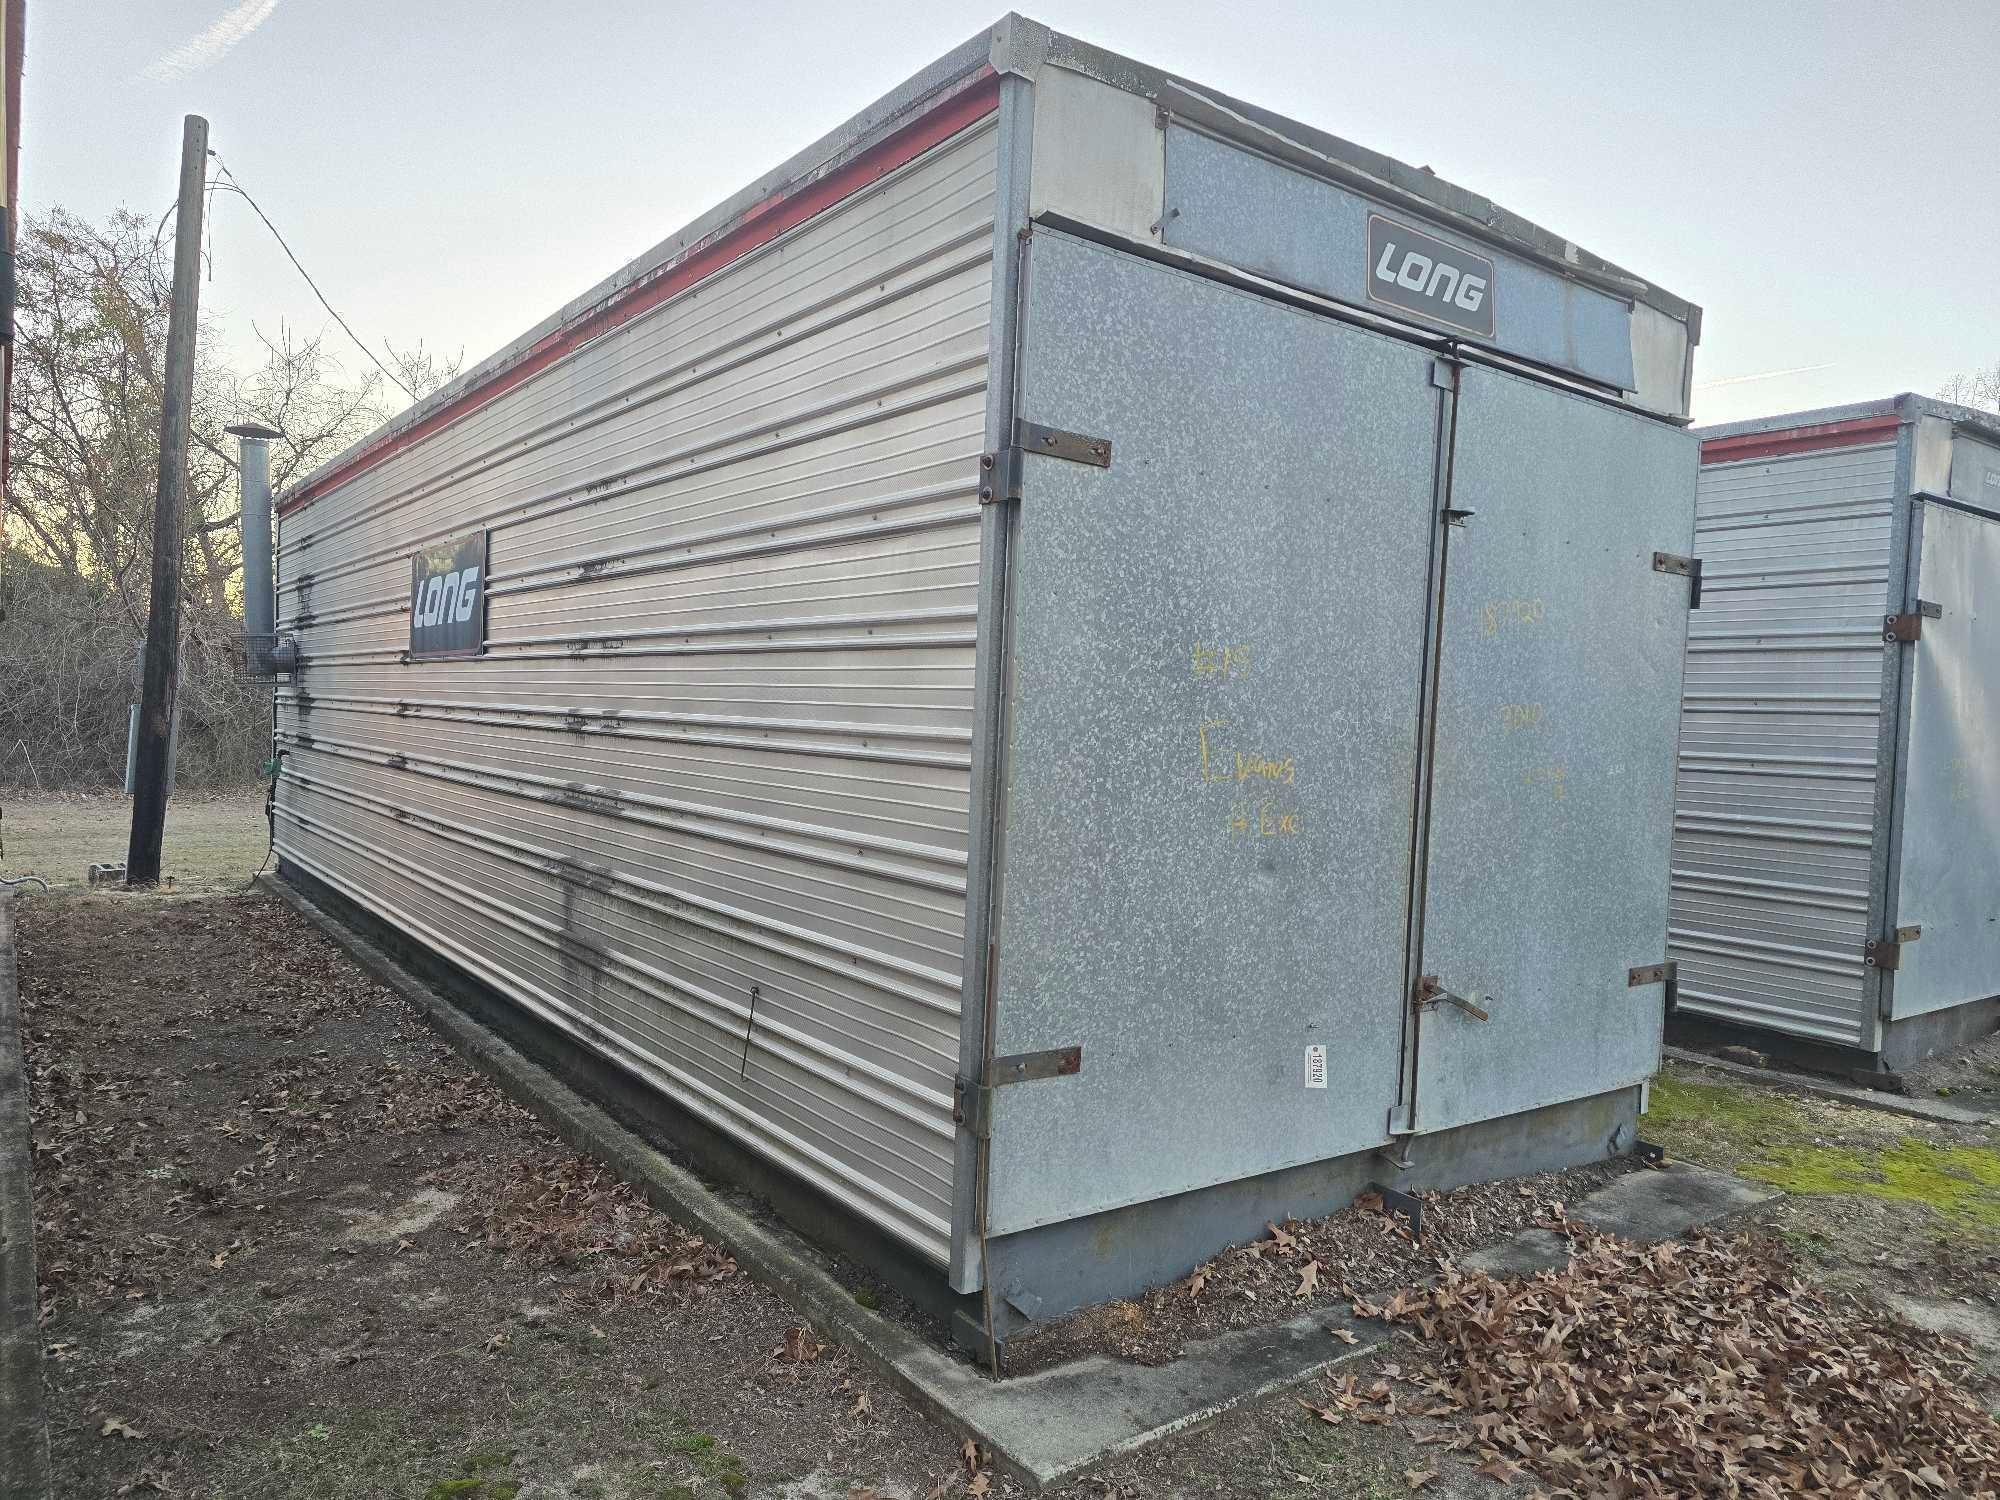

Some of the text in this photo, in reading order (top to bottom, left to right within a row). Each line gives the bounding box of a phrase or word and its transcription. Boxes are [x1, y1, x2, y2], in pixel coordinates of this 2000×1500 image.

[1376, 242, 1487, 312] LONG
[414, 566, 479, 629] LONG
[1312, 1053, 1324, 1083] 187920
